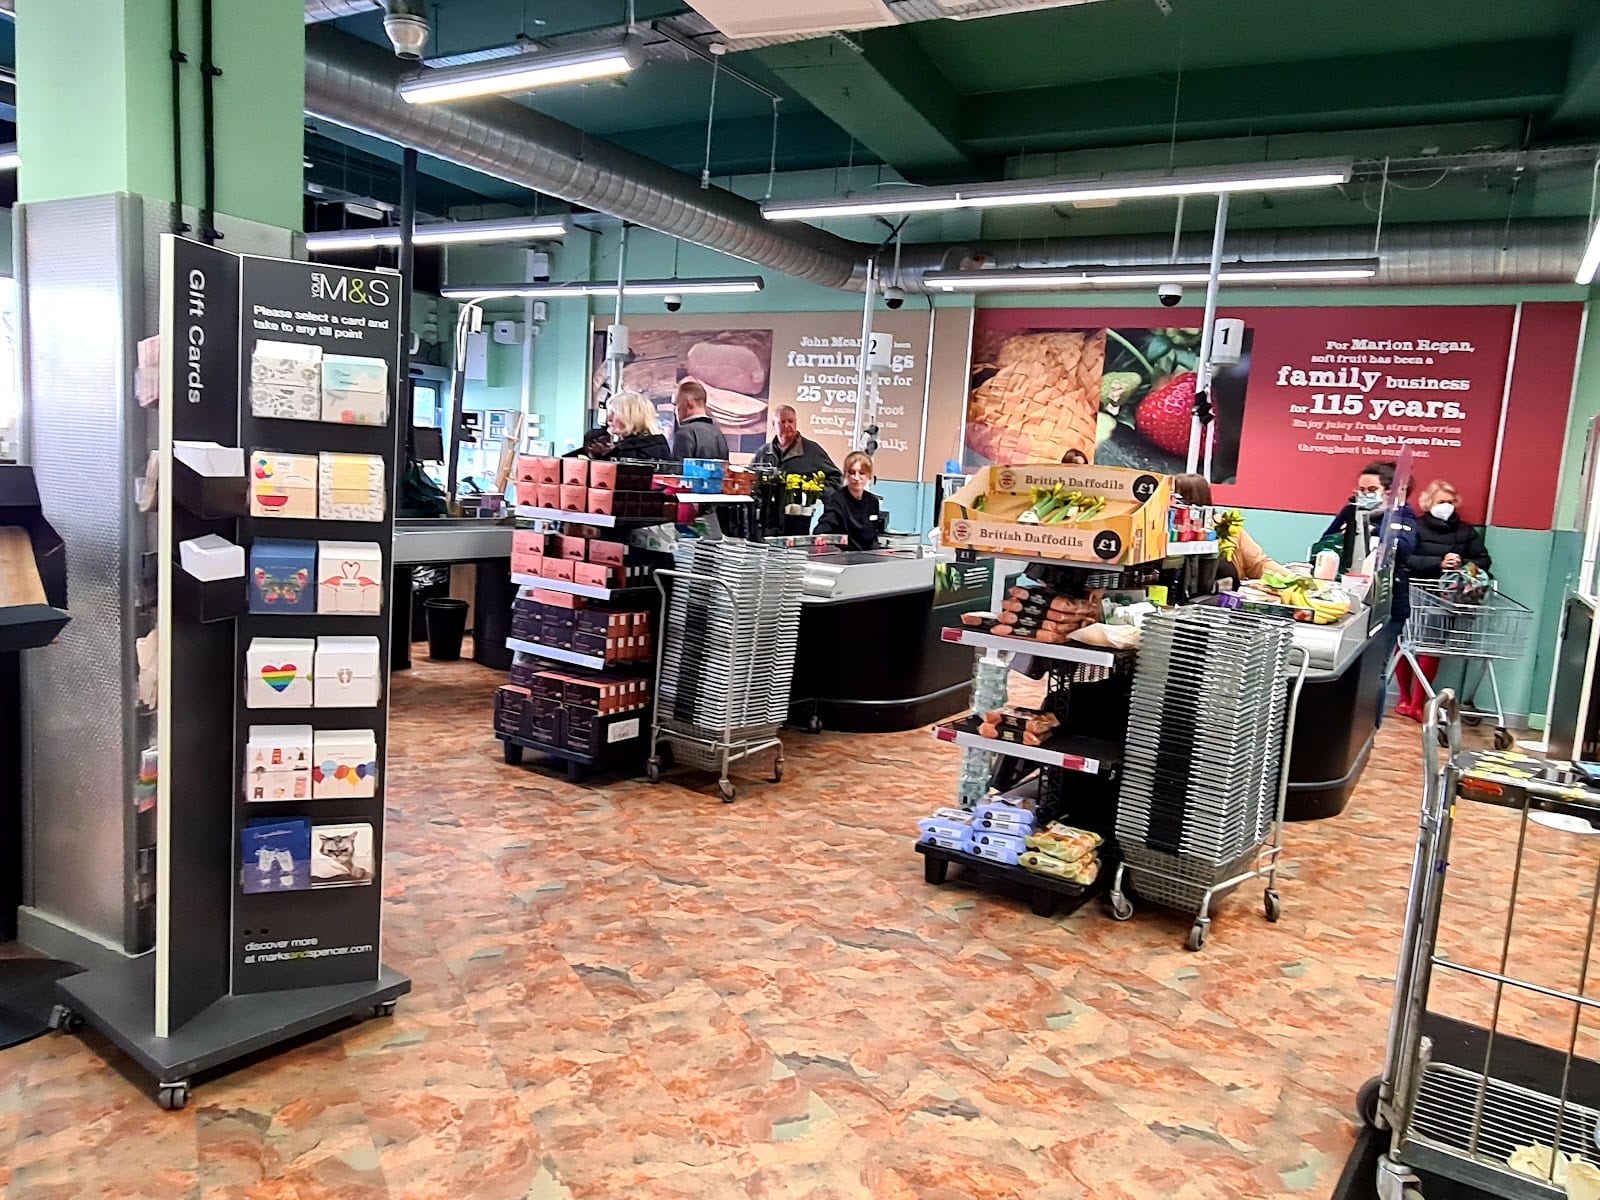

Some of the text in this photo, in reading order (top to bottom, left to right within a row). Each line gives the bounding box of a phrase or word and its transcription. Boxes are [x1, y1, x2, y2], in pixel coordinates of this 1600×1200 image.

[311, 272, 390, 307] YOUR M&S
[253, 304, 389, 329] Please select a card and
[187, 269, 205, 403] Gift Cards
[253, 319, 363, 340] take to any till point
[1220, 327, 1230, 345] 1
[801, 336, 829, 347] John
[831, 337, 862, 347] Mear
[869, 339, 877, 354] 2
[1326, 338, 1475, 354] For Marion Regan,
[888, 355, 914, 373] gs
[1311, 355, 1335, 363] soft
[1336, 355, 1367, 363] fruit
[1369, 355, 1391, 364] has
[1393, 356, 1423, 365] been
[803, 374, 816, 384] in
[893, 375, 913, 387] for
[1276, 366, 1470, 392] family business
[796, 385, 821, 402] 25
[878, 405, 905, 417] root
[1289, 394, 1466, 421] for 115 years.
[809, 414, 846, 430] freely
[1292, 418, 1461, 434] Enjoy juicy fresh strawberries
[1314, 431, 1461, 447] from her Hugh Lowe farm
[1298, 443, 1360, 455] throughout
[1361, 446, 1380, 455] the
[1024, 474, 1065, 487] British
[1068, 477, 1125, 490] Daffodils
[1136, 485, 1154, 495] £1
[979, 528, 1021, 541] British
[1024, 532, 1083, 547] Daffodils
[1097, 539, 1117, 552] £1
[244, 938, 318, 952] discover more
[244, 944, 372, 964] at marksandspencer.com
